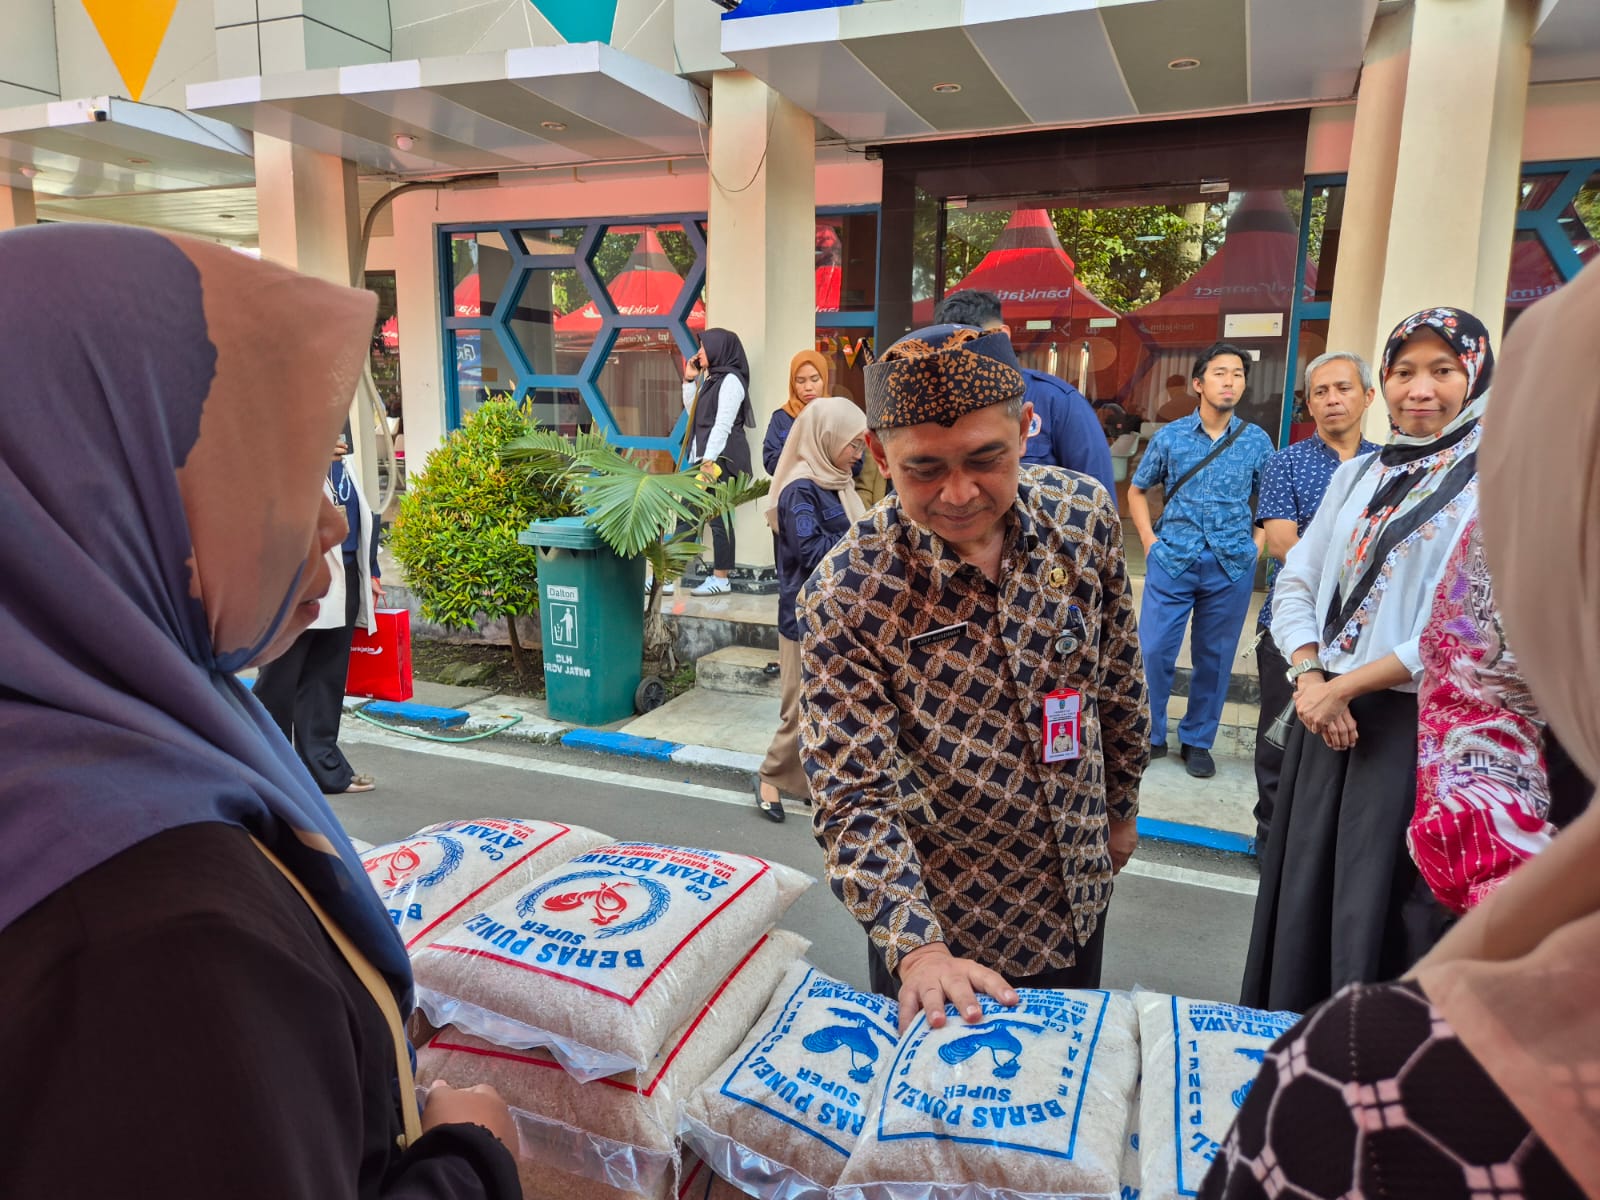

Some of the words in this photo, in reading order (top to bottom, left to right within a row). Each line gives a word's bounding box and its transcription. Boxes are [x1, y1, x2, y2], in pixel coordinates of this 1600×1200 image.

[549, 587, 575, 599] Dalton
[555, 653, 573, 665] DLH
[457, 824, 524, 849] AYAM
[480, 844, 504, 861] Cap
[668, 856, 710, 871] MAUFA
[656, 864, 729, 889] AYAM
[713, 866, 732, 879] UD.
[684, 884, 713, 902] Cap
[521, 919, 587, 946] SUPER
[536, 942, 646, 969] BERAS
[807, 987, 883, 1016] KETAWA
[1023, 1004, 1086, 1024] AYAM
[1042, 1020, 1066, 1033] Cap
[900, 1031, 930, 1076] PUNE
[1058, 1030, 1084, 1097] ENAK
[748, 1056, 815, 1114] PUNEL
[796, 1067, 861, 1107] SUPER
[944, 1084, 1012, 1102] SUPER
[1188, 1039, 1203, 1125] PUNEL
[893, 1080, 964, 1126] PUNEL
[972, 1099, 1066, 1129] BERAS
[817, 1102, 867, 1137] RAS
